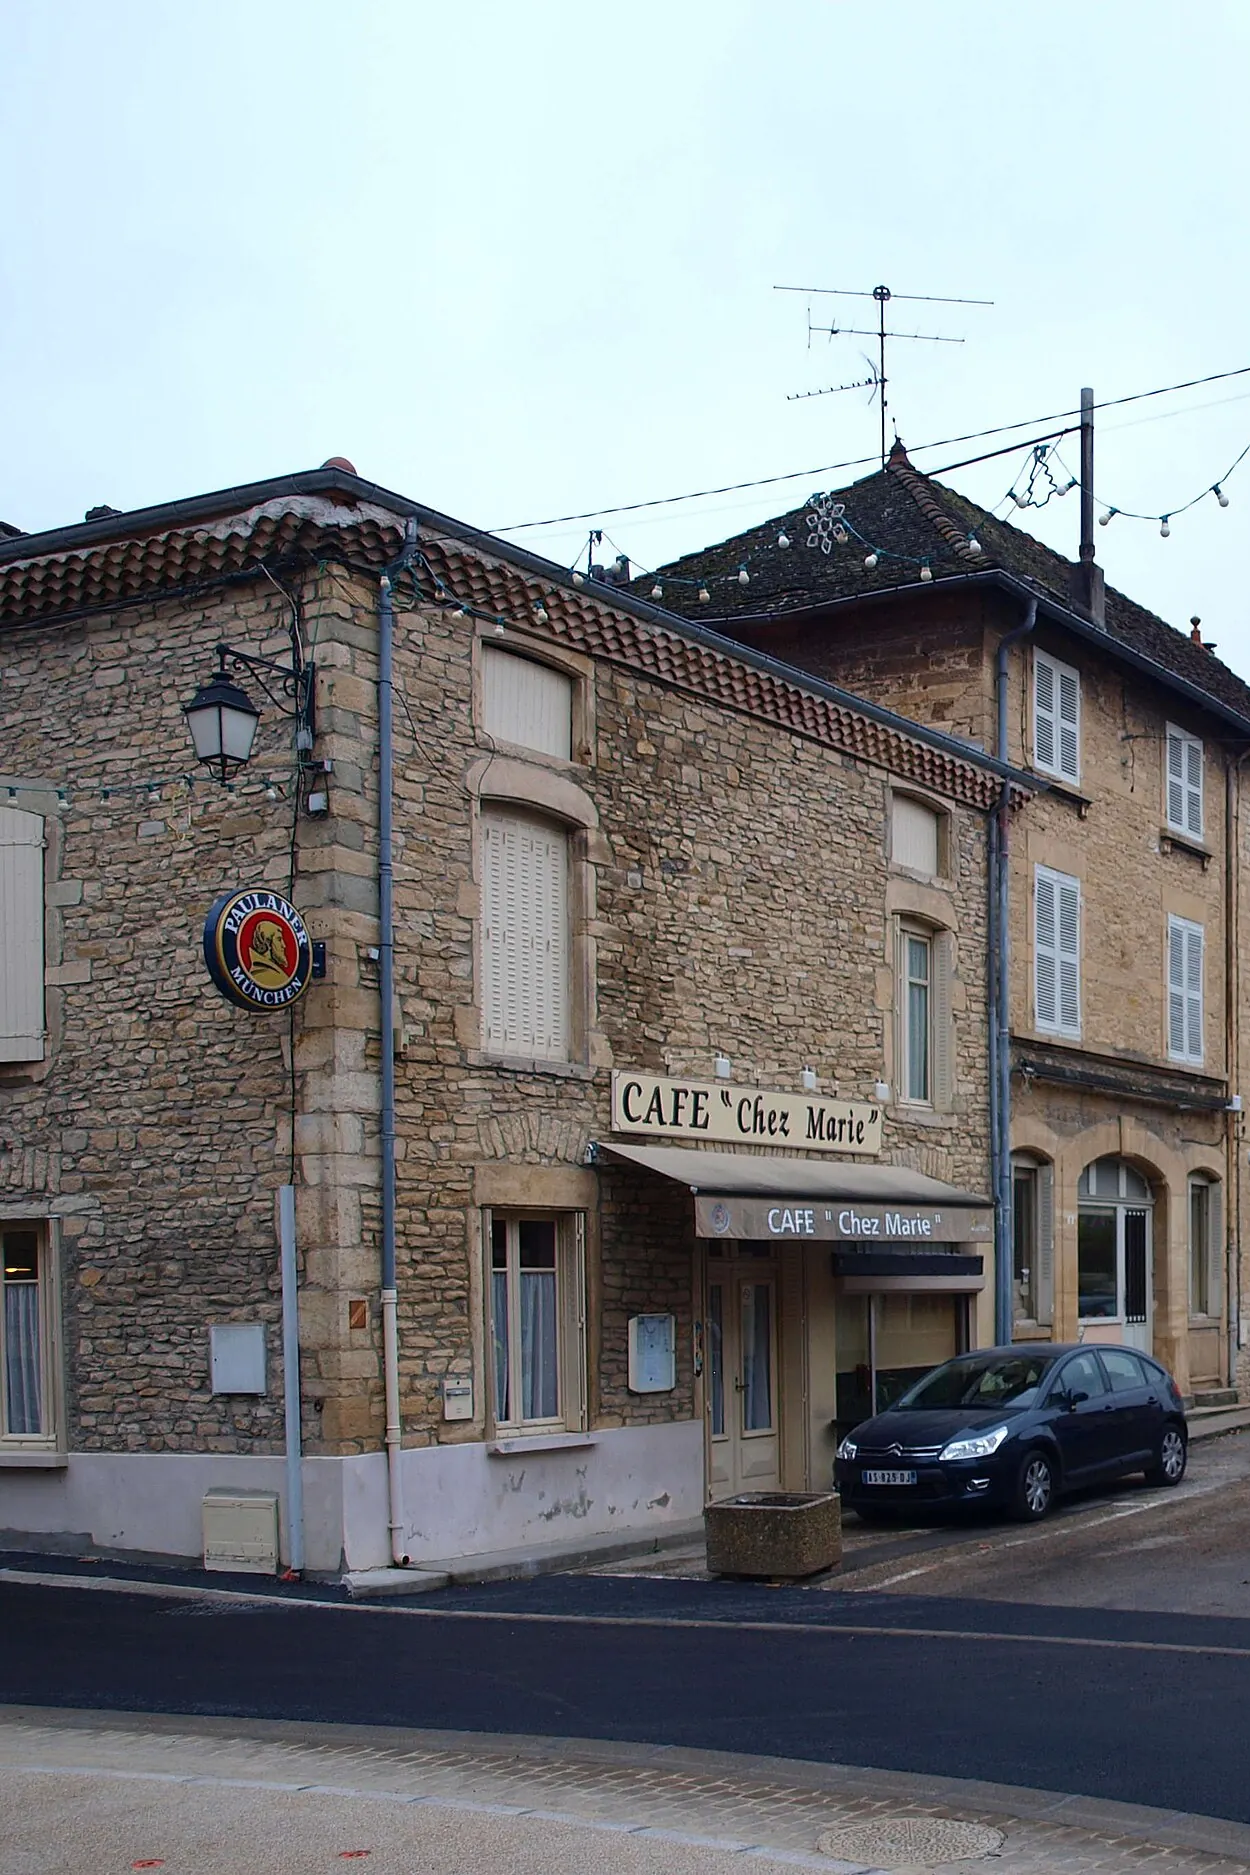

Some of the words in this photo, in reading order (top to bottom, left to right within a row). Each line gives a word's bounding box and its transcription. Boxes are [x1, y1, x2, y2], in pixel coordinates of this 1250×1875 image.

[225, 893, 308, 948] PAULANER
[622, 1081, 710, 1130] CAFE
[767, 1208, 815, 1235] CAFE
